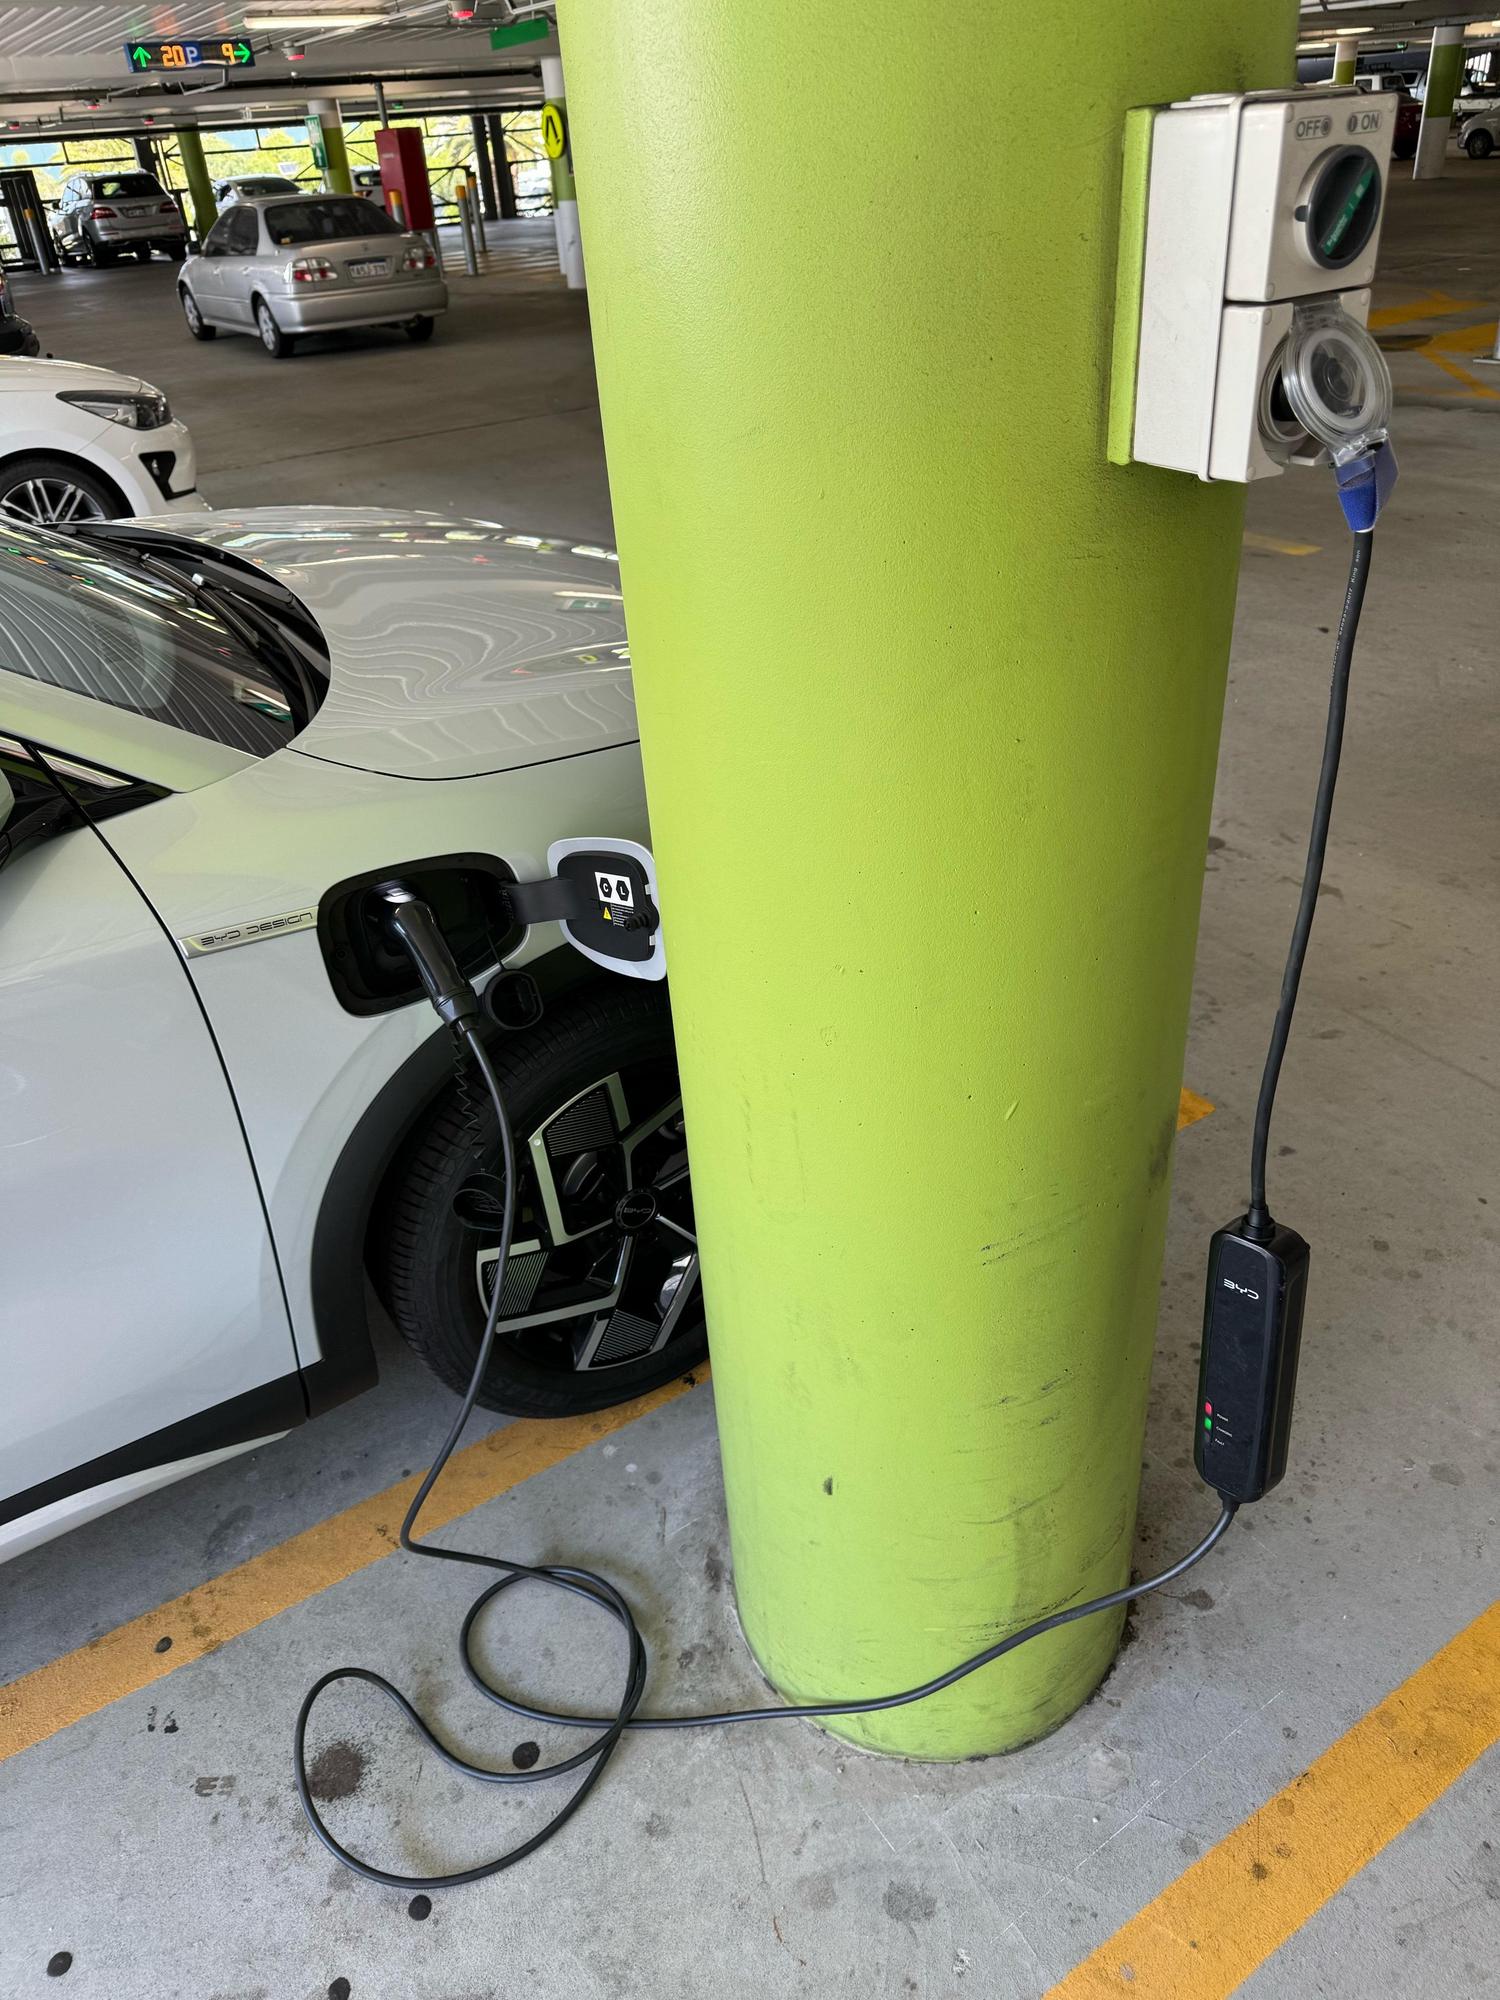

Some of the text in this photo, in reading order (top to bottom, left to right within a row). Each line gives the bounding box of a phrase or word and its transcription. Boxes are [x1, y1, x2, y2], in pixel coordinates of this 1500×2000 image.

[160, 45, 186, 67] 20
[221, 43, 236, 65] 9
[1296, 119, 1321, 137] OFF
[1361, 112, 1379, 130] ON
[602, 882, 626, 896] C L
[200, 911, 313, 946] BYD DESIGN
[1223, 1278, 1260, 1300] BYD
